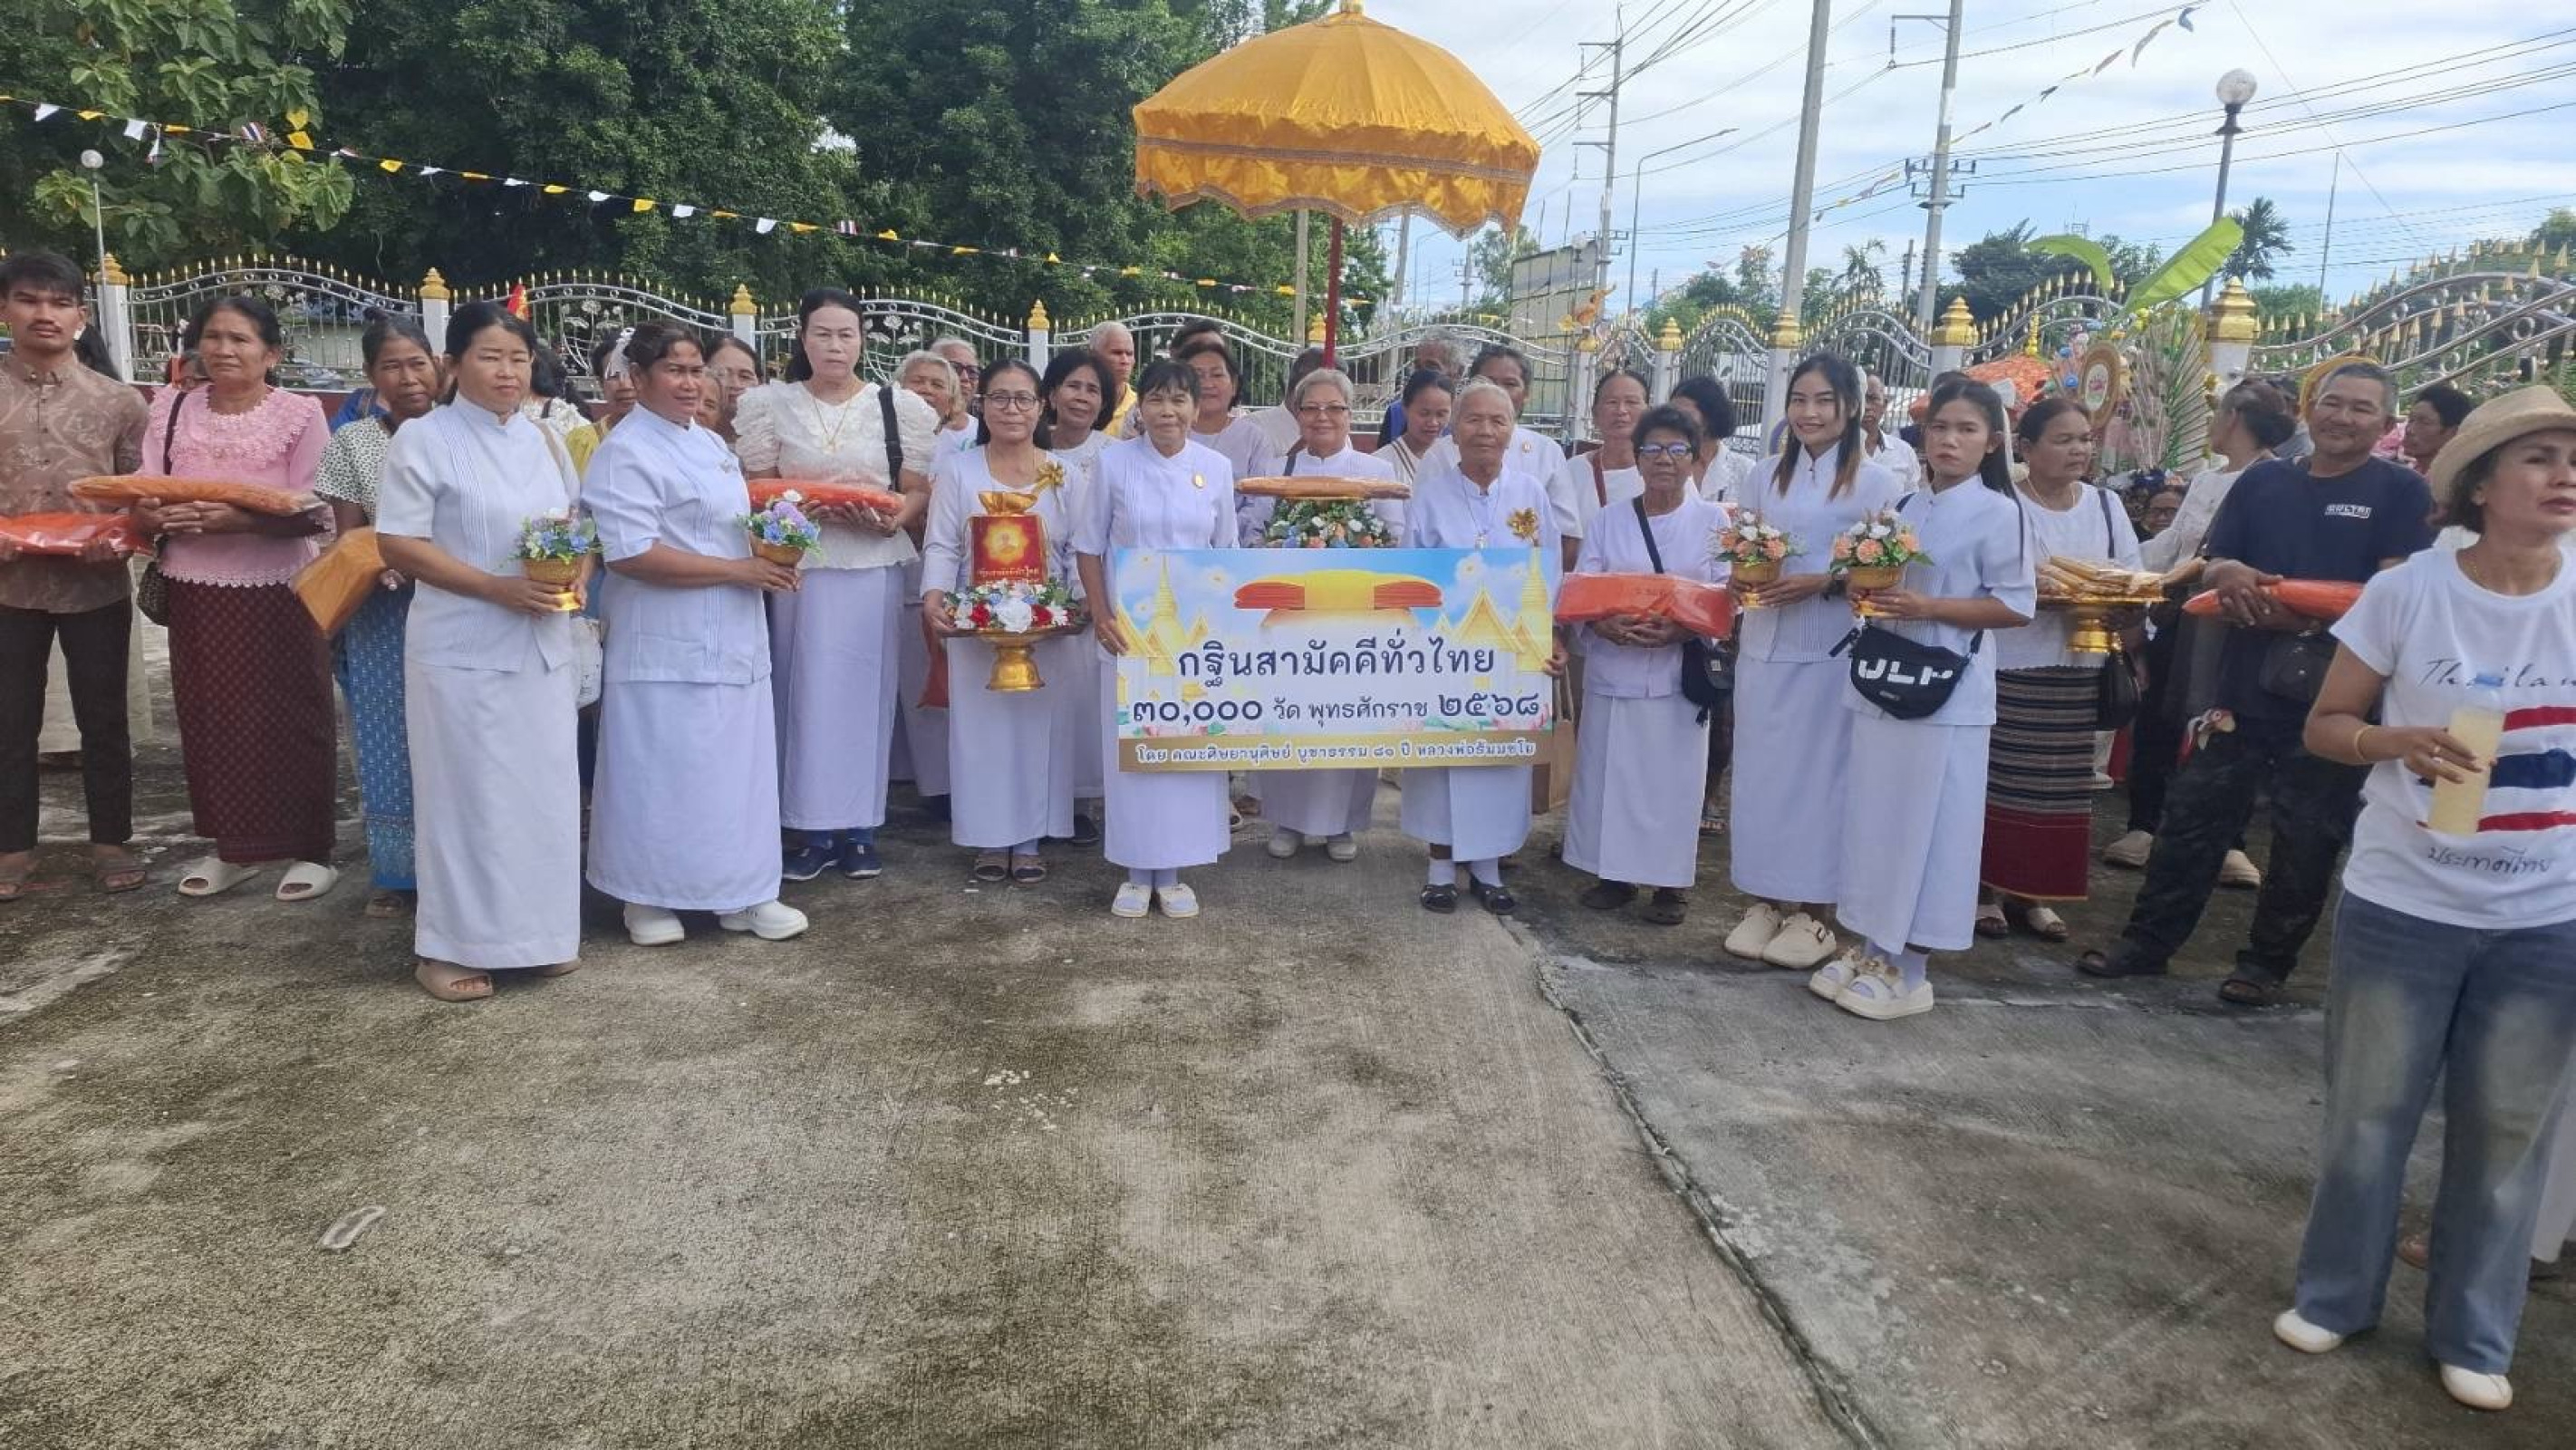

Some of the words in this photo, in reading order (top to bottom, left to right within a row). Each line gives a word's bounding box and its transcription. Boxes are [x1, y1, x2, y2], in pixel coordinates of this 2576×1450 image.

[1178, 628, 1495, 687] กฐินสามัคคีทั่วไทย
[1133, 700, 1263, 725] ๓๐,๐๐๐
[1272, 696, 1300, 720] วัด
[1309, 695, 1429, 728] พุทธศักราช
[1438, 691, 1540, 717] ๒๕๖๘
[1137, 745, 1167, 762] โดย
[1298, 743, 1368, 763] บูชาธรรม
[1400, 741, 1412, 757] ปี
